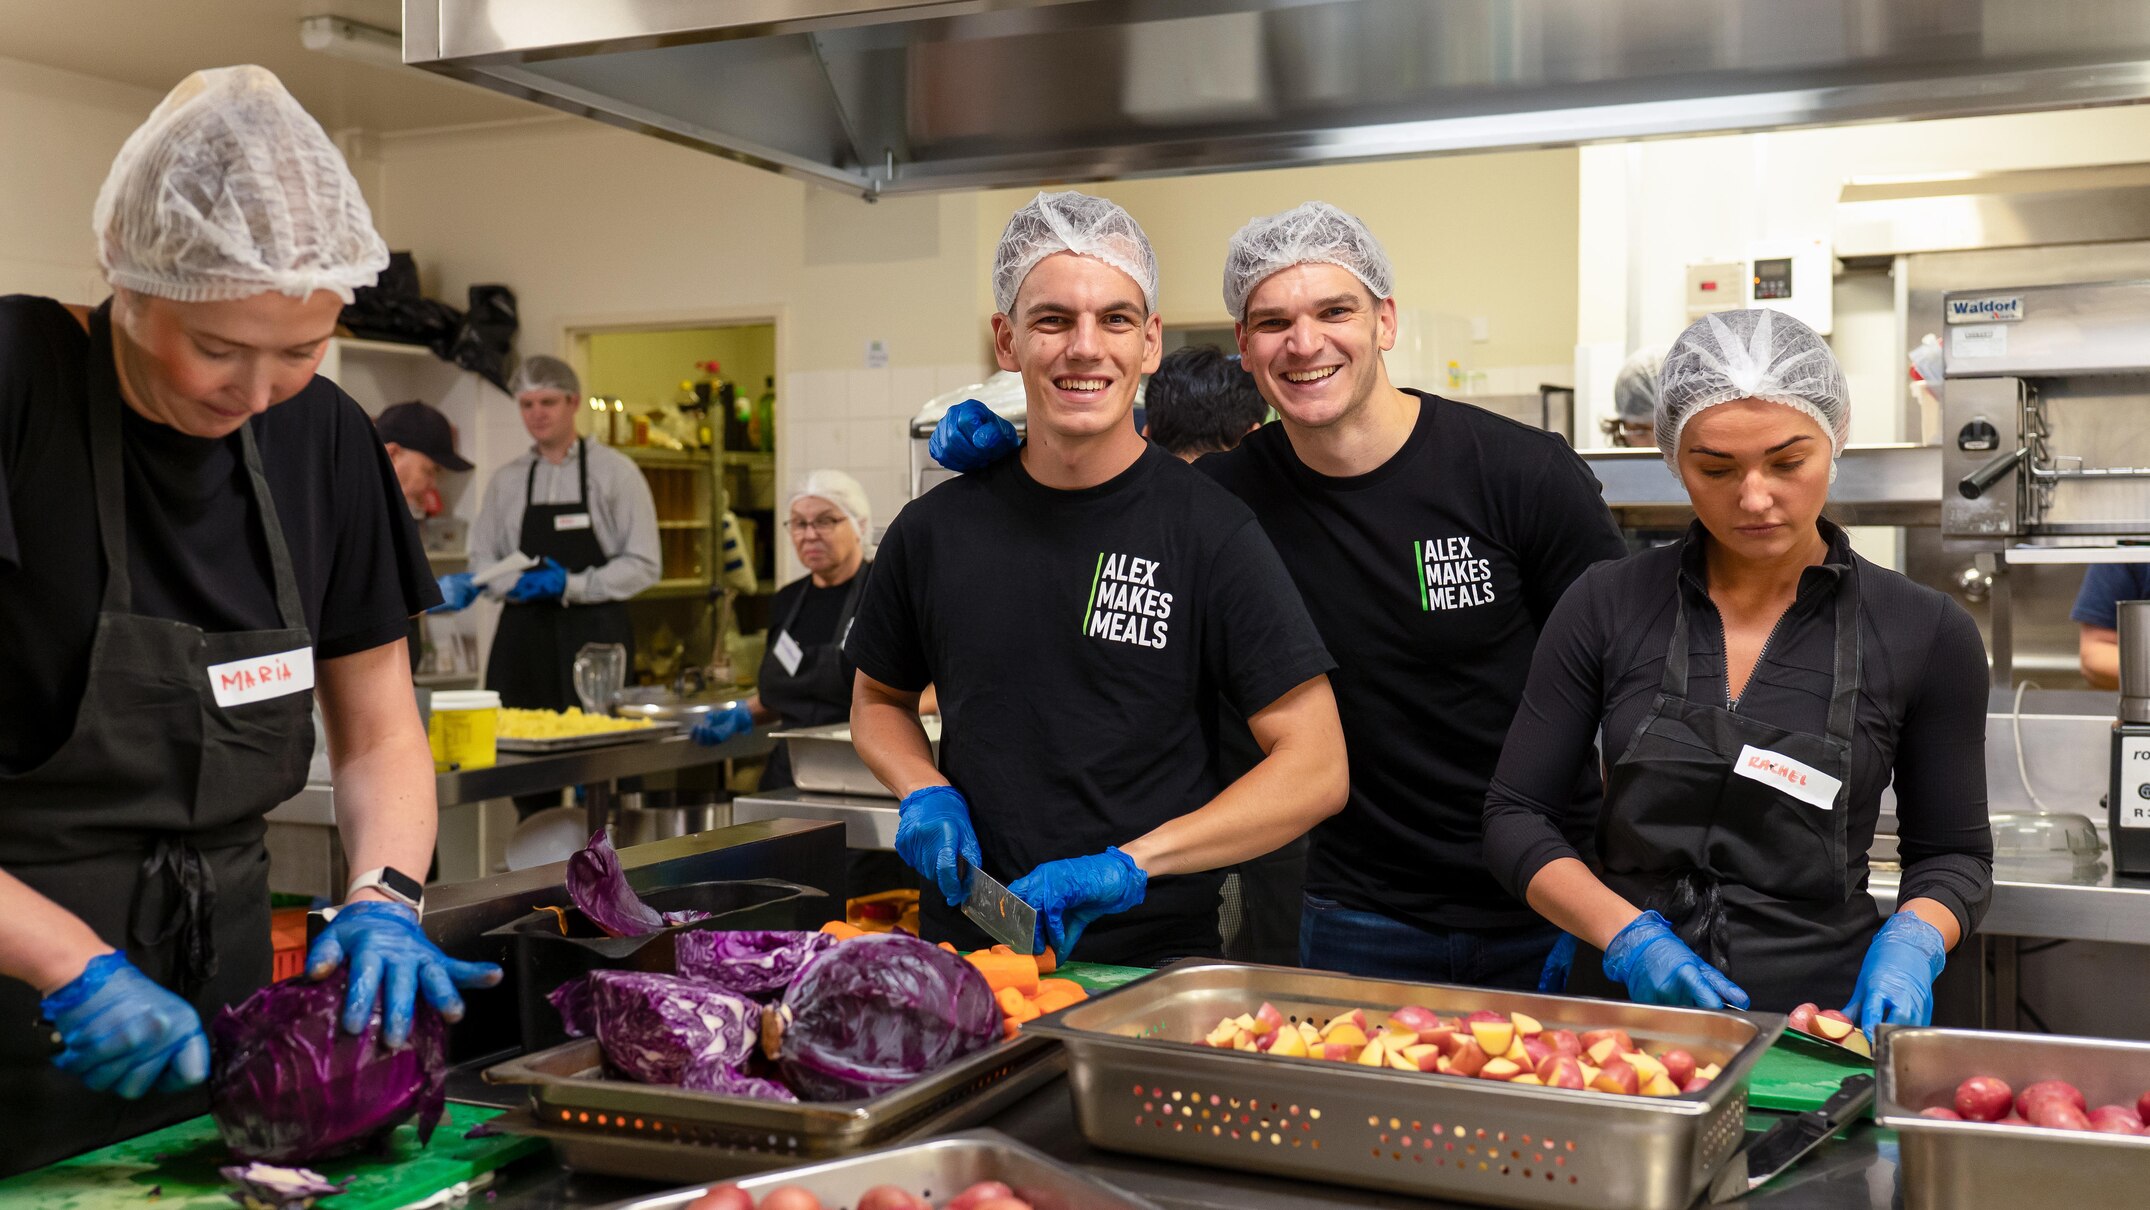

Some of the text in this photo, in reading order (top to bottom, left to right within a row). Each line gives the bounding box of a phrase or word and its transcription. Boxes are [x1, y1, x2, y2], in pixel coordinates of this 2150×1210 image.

[1953, 299, 2017, 314] Waldorf
[1424, 536, 1473, 563] ALEX
[1101, 553, 1160, 587] ALEX
[1425, 558, 1491, 586] MAKES
[1096, 581, 1173, 619] MAKES
[1428, 582, 1495, 611] MEALS
[1089, 610, 1168, 649] MEALS
[1747, 756, 1807, 786] RACHEL
